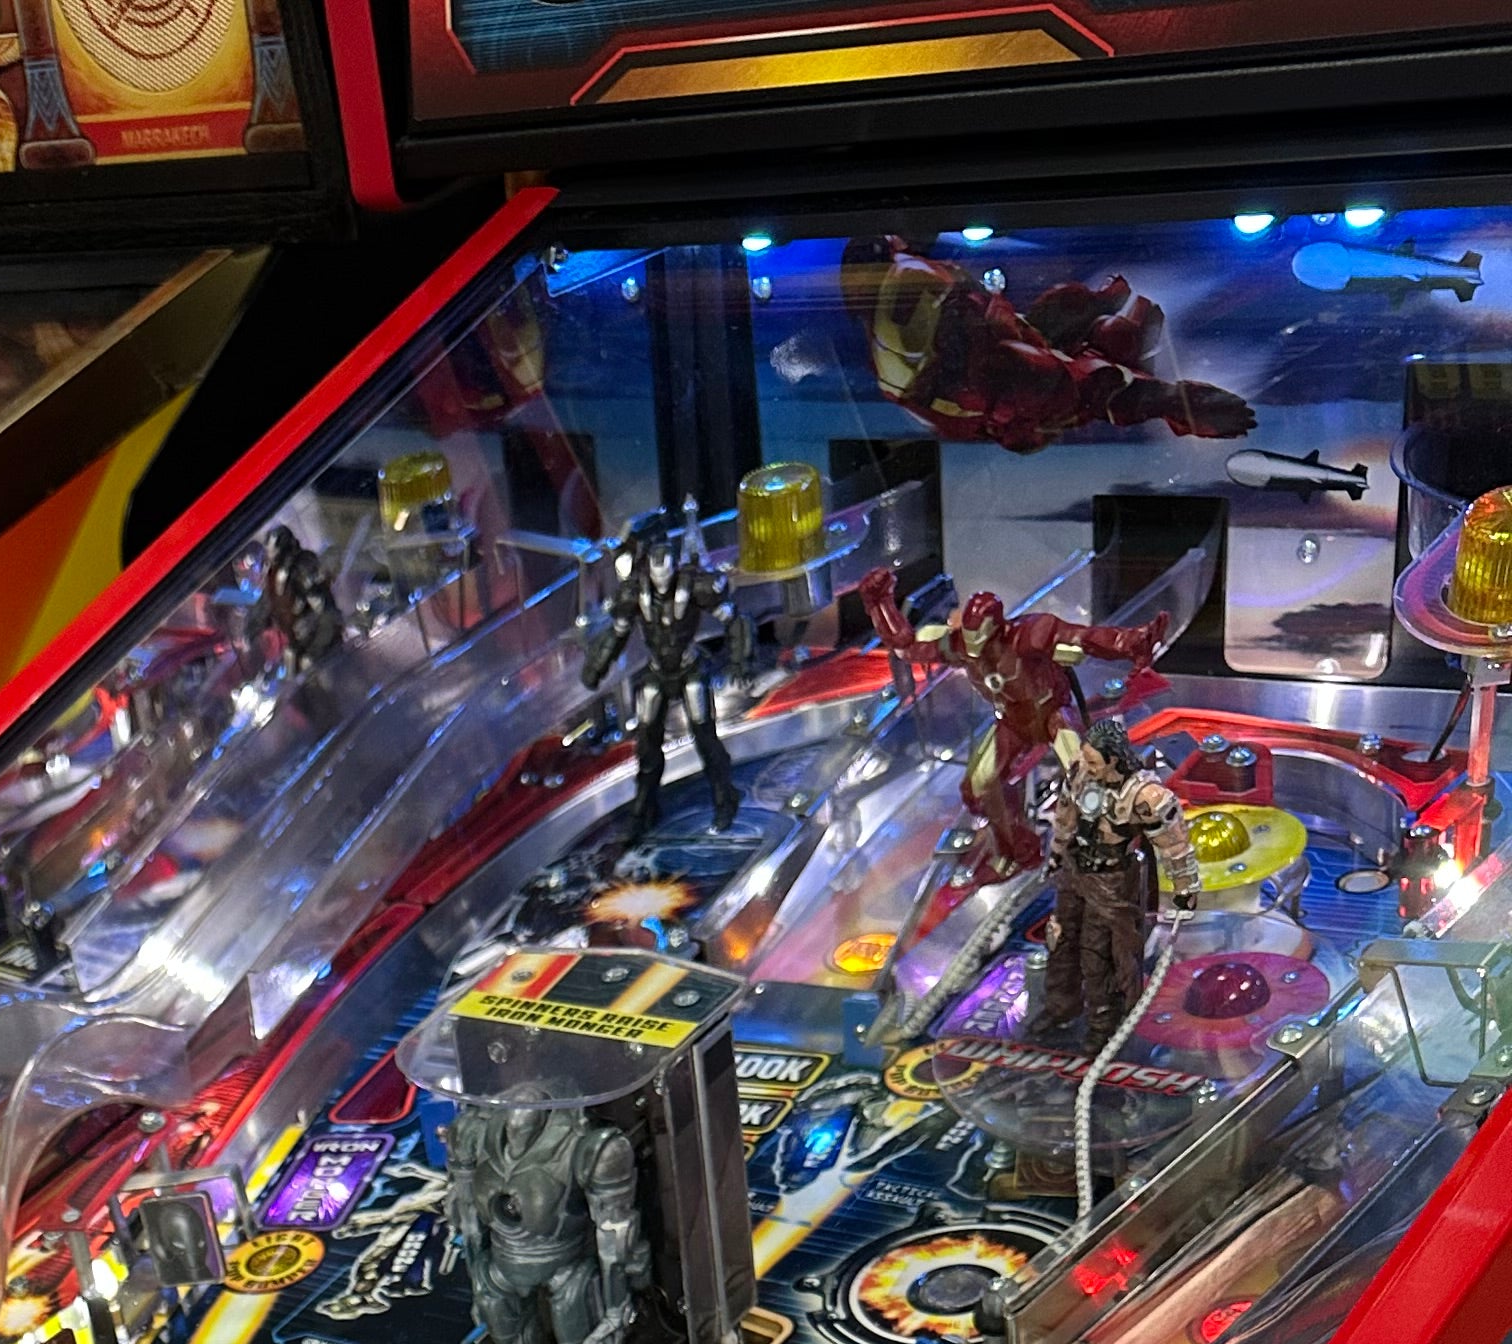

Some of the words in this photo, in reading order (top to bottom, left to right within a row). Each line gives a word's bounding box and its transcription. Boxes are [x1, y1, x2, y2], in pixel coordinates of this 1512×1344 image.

[478, 995, 596, 1023] SPINNERS
[598, 1012, 674, 1033] RAISE
[483, 1006, 542, 1024] IRON
[543, 1016, 646, 1039] MONGER
[734, 1054, 814, 1083] 00K
[312, 1140, 382, 1154] IRON
